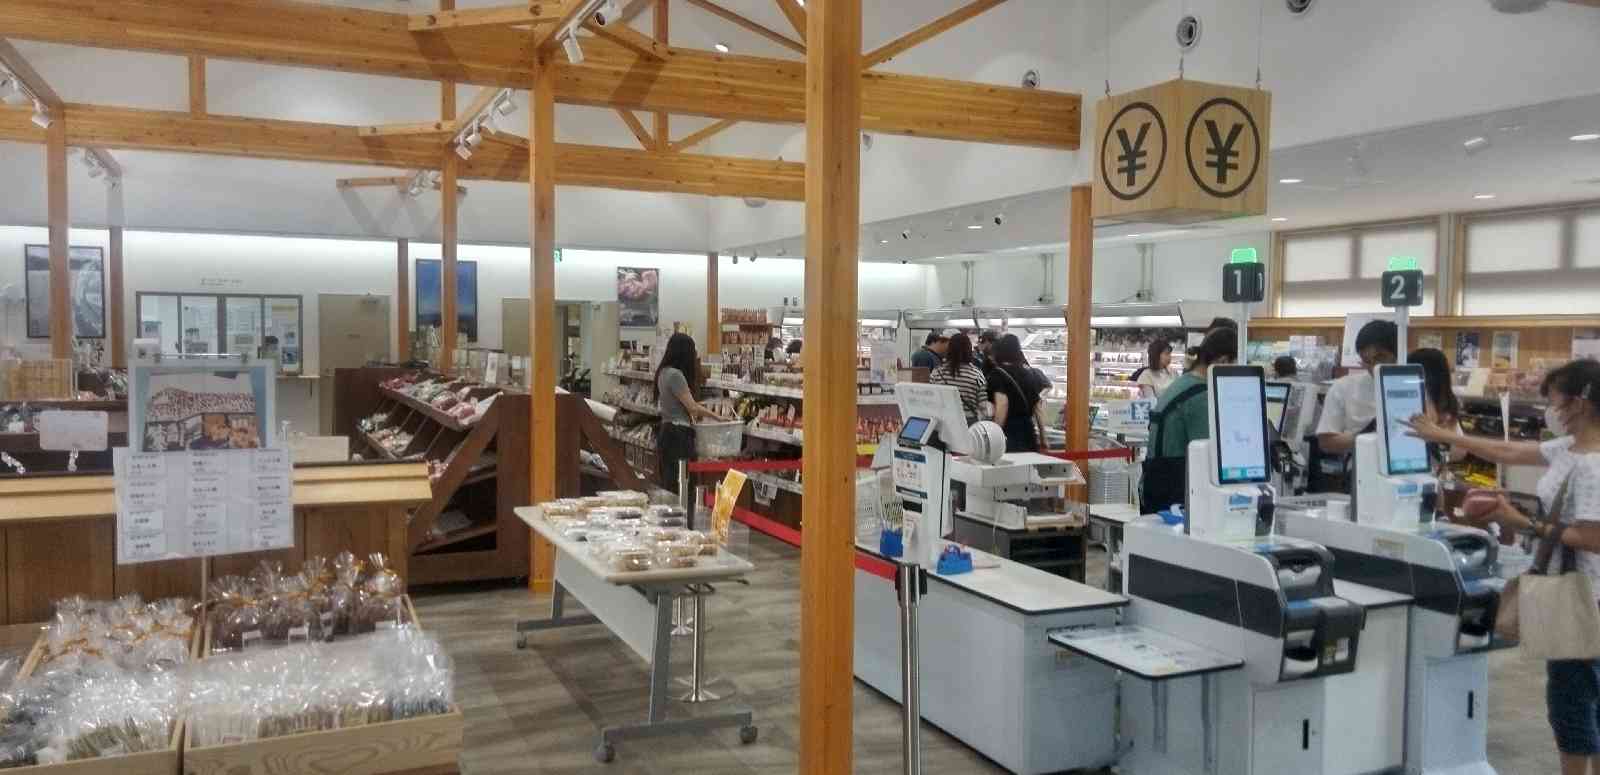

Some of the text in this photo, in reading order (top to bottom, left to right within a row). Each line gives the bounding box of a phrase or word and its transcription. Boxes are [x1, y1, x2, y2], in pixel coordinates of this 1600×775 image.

[1116, 122, 1151, 186] ¥
[1204, 120, 1244, 184] ¥
[1233, 269, 1241, 295] 1
[1391, 275, 1406, 299] 2
